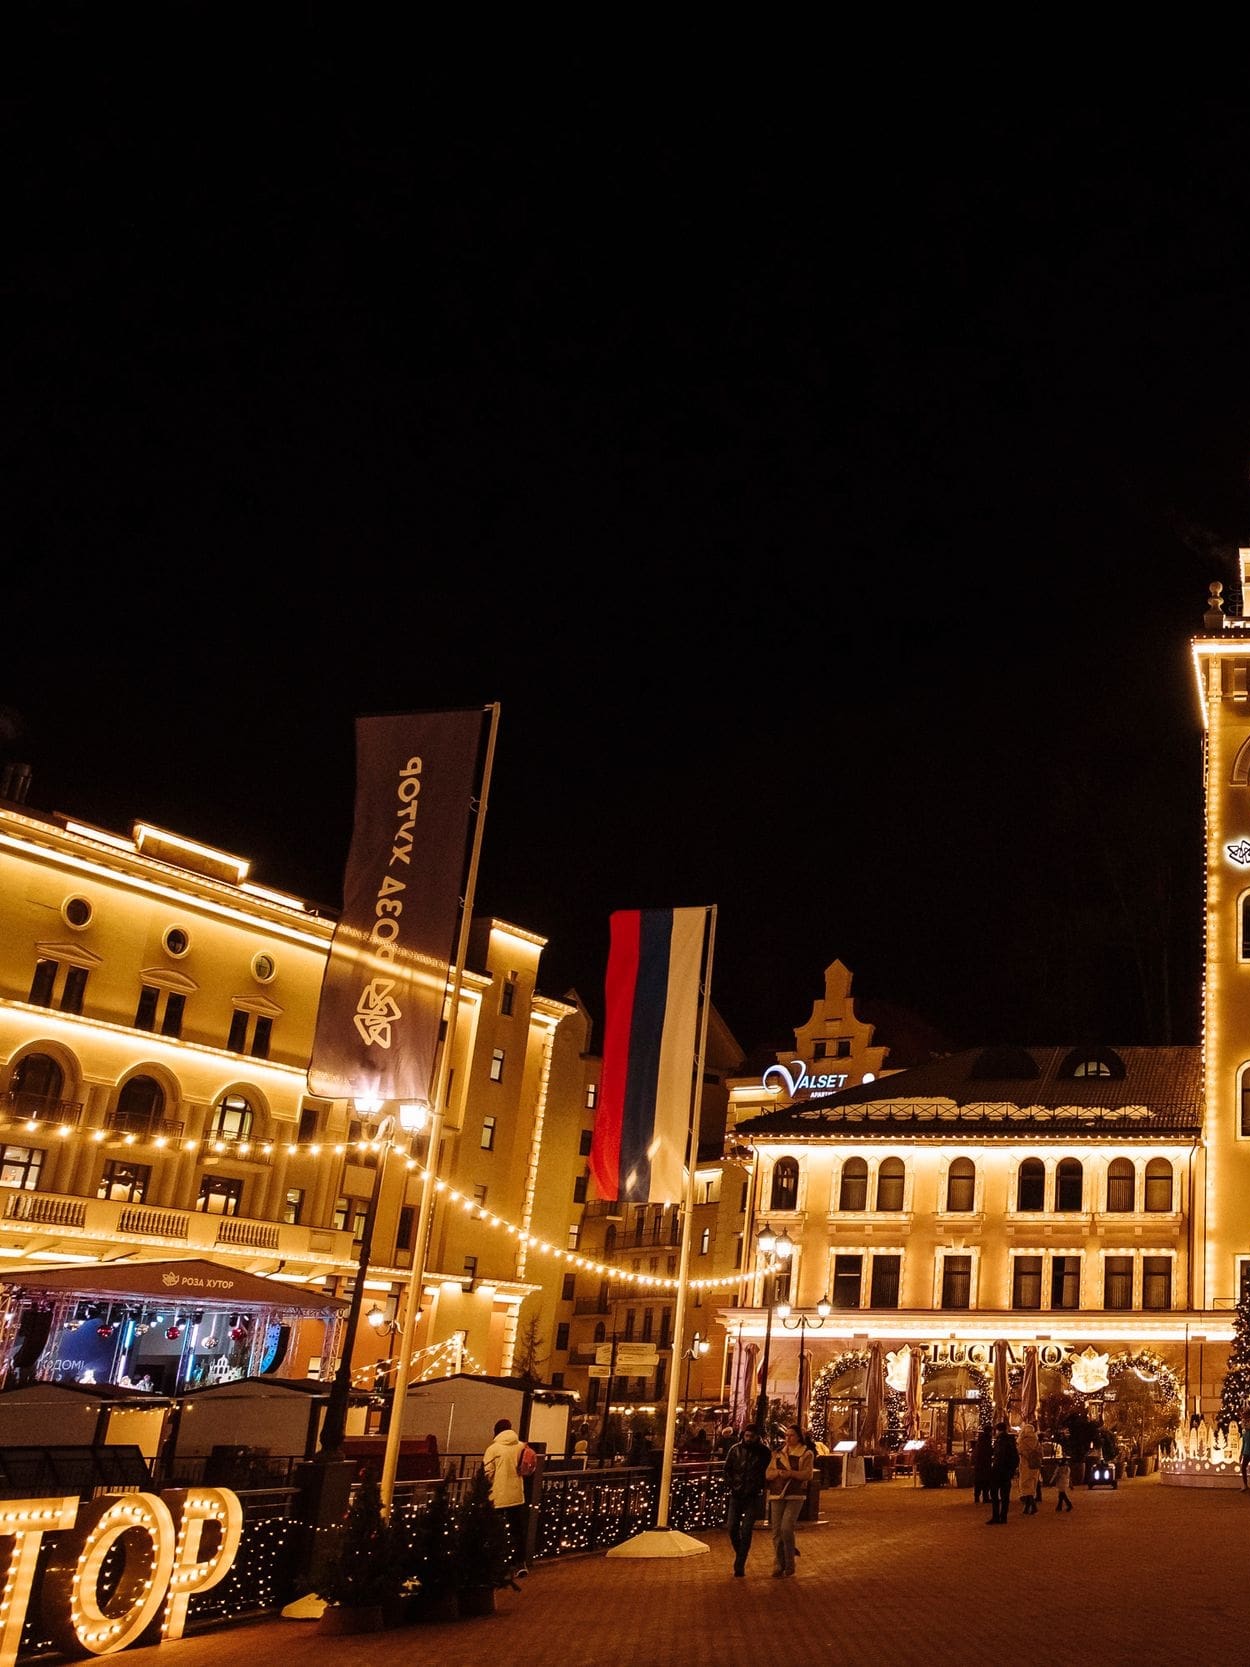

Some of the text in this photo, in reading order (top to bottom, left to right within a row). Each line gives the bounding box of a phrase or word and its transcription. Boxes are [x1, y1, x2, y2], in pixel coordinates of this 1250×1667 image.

[763, 1060, 848, 1098] VALSET
[181, 1277, 234, 1289] РОЗА ХУТОР
